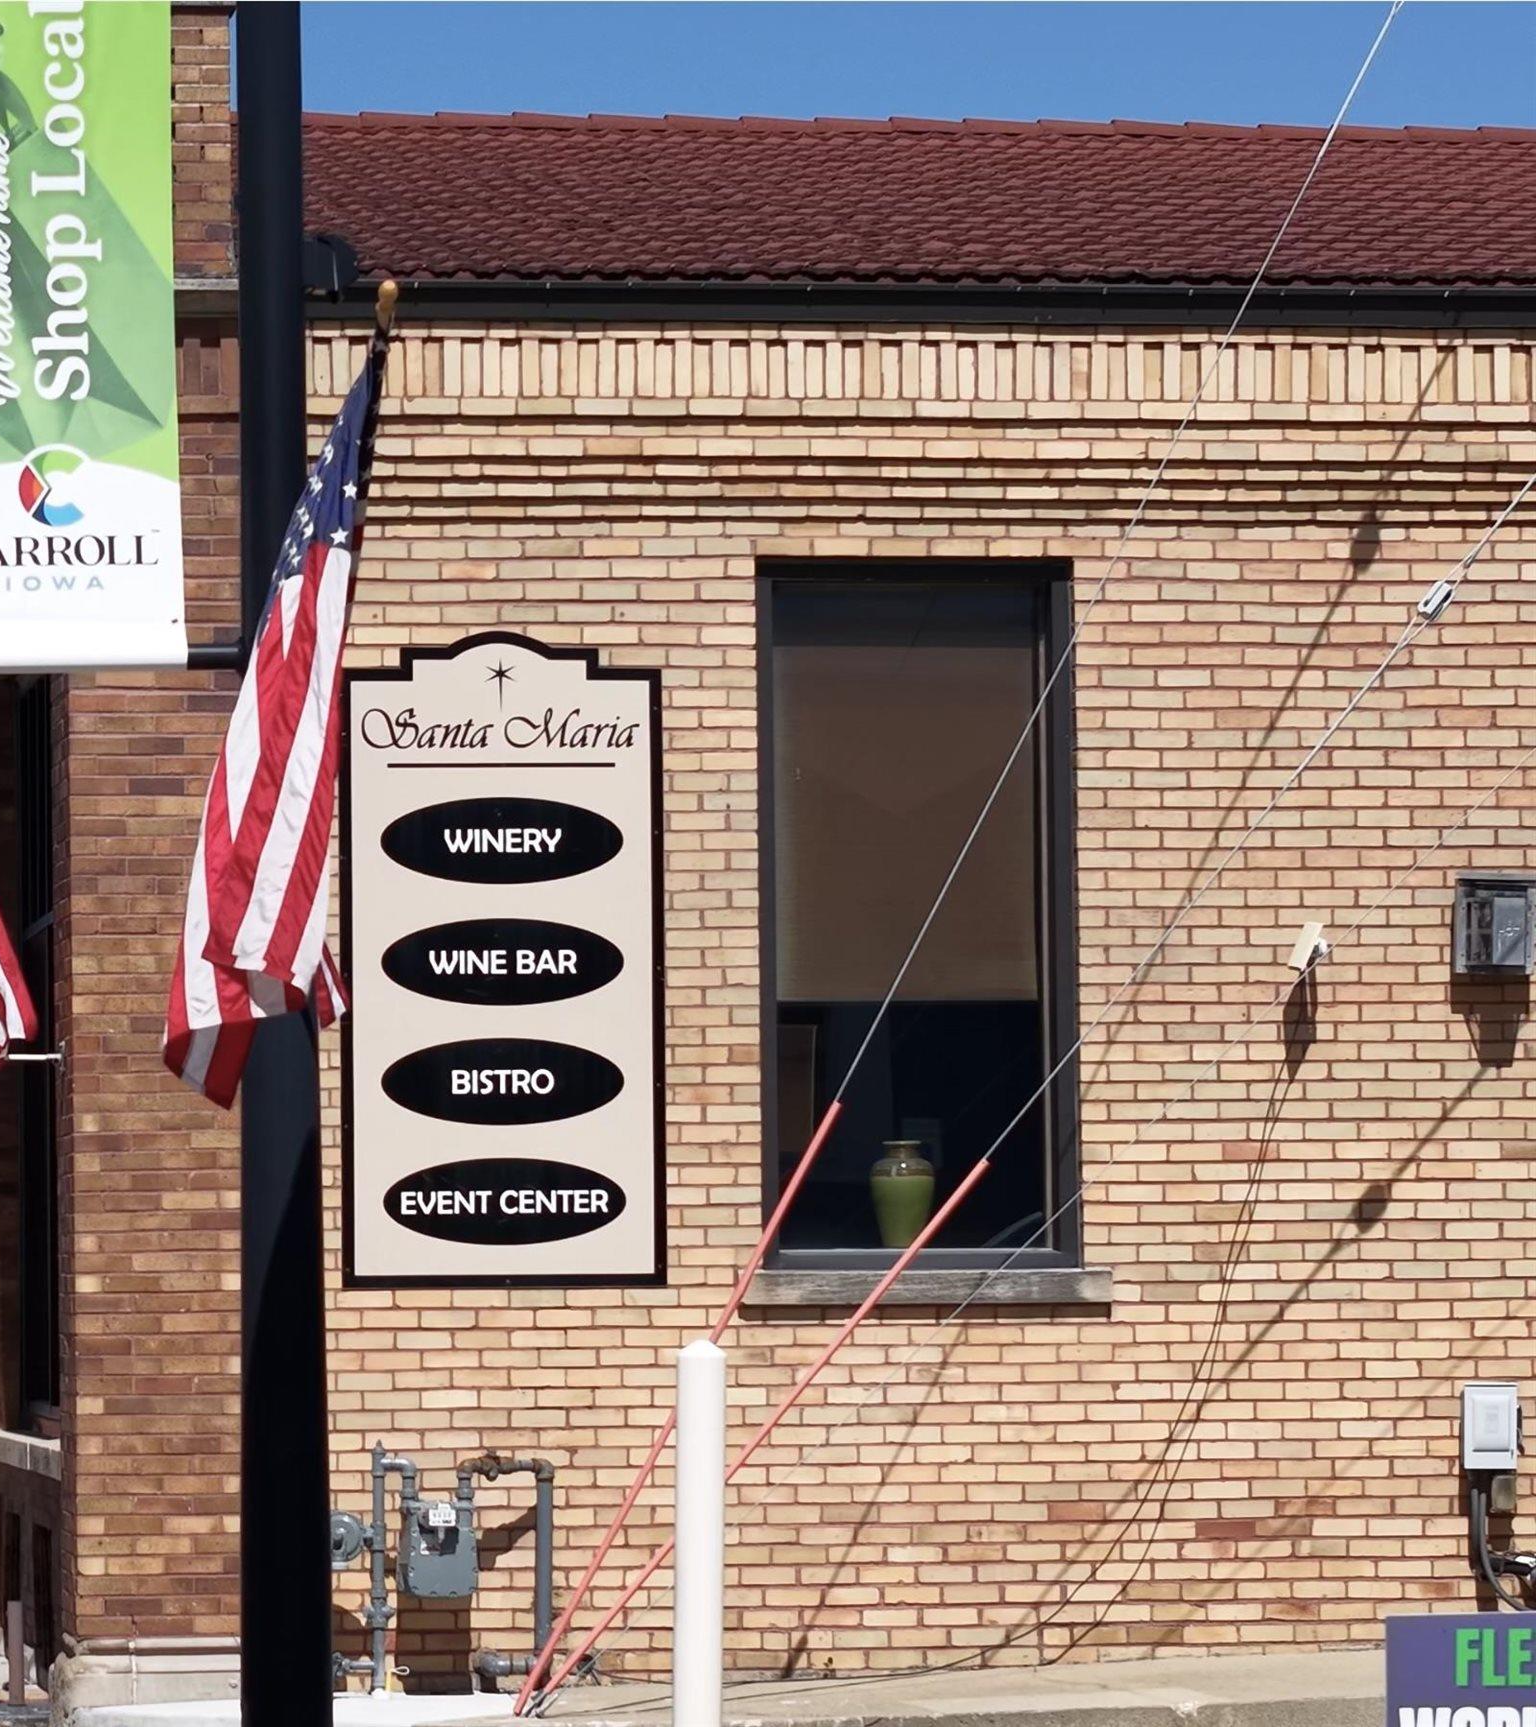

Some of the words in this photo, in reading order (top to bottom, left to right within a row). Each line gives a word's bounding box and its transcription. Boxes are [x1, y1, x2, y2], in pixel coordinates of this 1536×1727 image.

[27, 0, 86, 197] Local
[32, 213, 103, 402] Shop
[5, 575, 105, 592] IOWA
[361, 707, 494, 750] Santa
[503, 706, 640, 750] Maria
[443, 827, 563, 854] WINERY
[428, 949, 508, 976] WINE
[515, 949, 578, 975] BAR
[451, 1068, 555, 1095] BISTRO
[400, 1190, 492, 1215] EVENT
[499, 1189, 609, 1214] CENTER
[1456, 1628, 1536, 1687] FLE
